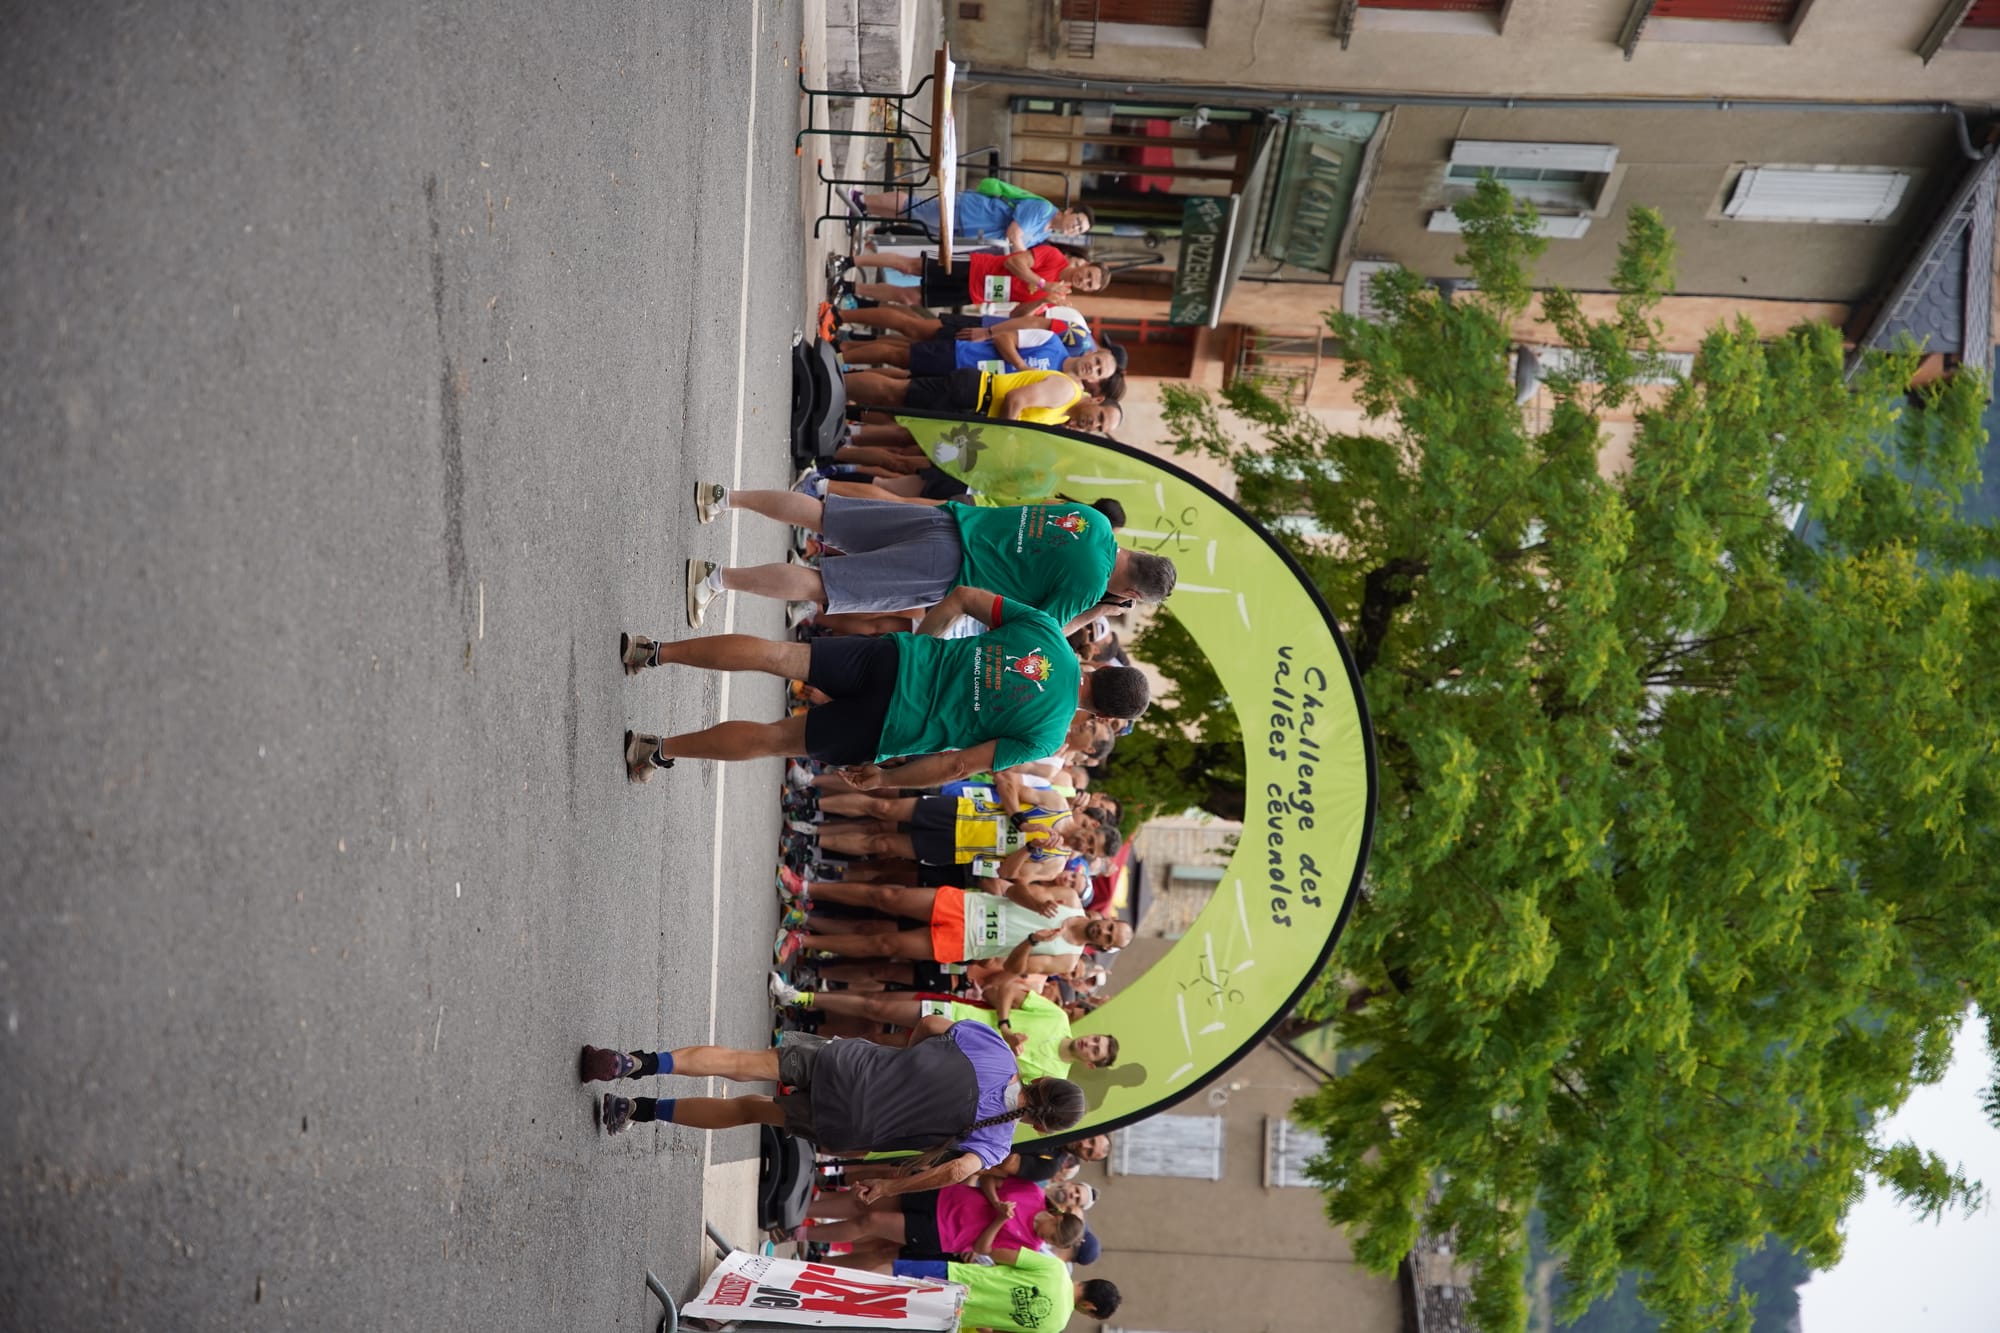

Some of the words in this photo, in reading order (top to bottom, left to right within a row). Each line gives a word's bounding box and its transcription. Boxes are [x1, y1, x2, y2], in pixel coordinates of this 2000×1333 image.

[993, 284, 1004, 298] 94
[1182, 234, 1216, 295] PIZZERIA
[1269, 646, 1295, 761] vallées
[1289, 667, 1327, 831] Challenge
[1007, 826, 1017, 844] 48
[1268, 783, 1292, 928] cévenoles
[1300, 854, 1322, 908] des
[986, 911, 998, 940] 115
